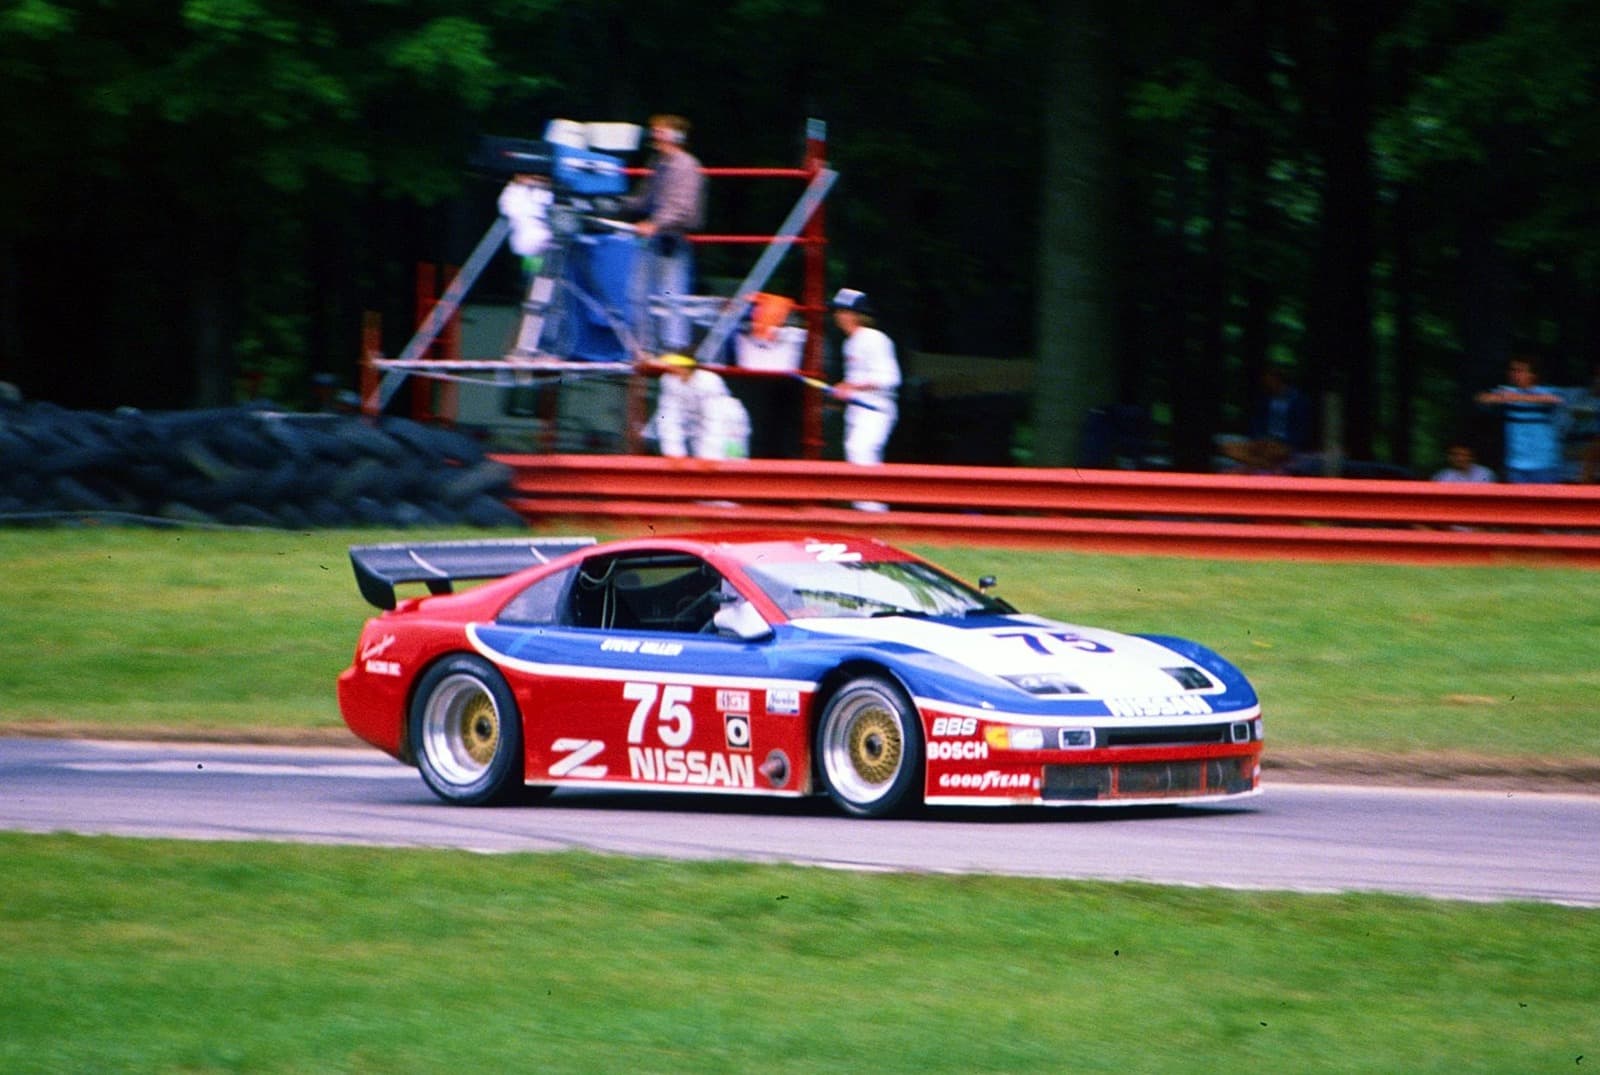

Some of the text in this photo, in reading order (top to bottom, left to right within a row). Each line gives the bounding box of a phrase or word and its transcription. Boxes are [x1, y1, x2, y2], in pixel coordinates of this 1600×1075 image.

[991, 632, 1114, 655] 75
[623, 682, 693, 747] 75
[1103, 695, 1213, 717] NISSAN
[932, 717, 977, 736] BBS
[548, 738, 608, 778] Z
[927, 741, 988, 760] BOSCH
[628, 747, 755, 788] NISSAN
[939, 770, 1031, 791] GOODYEAR
